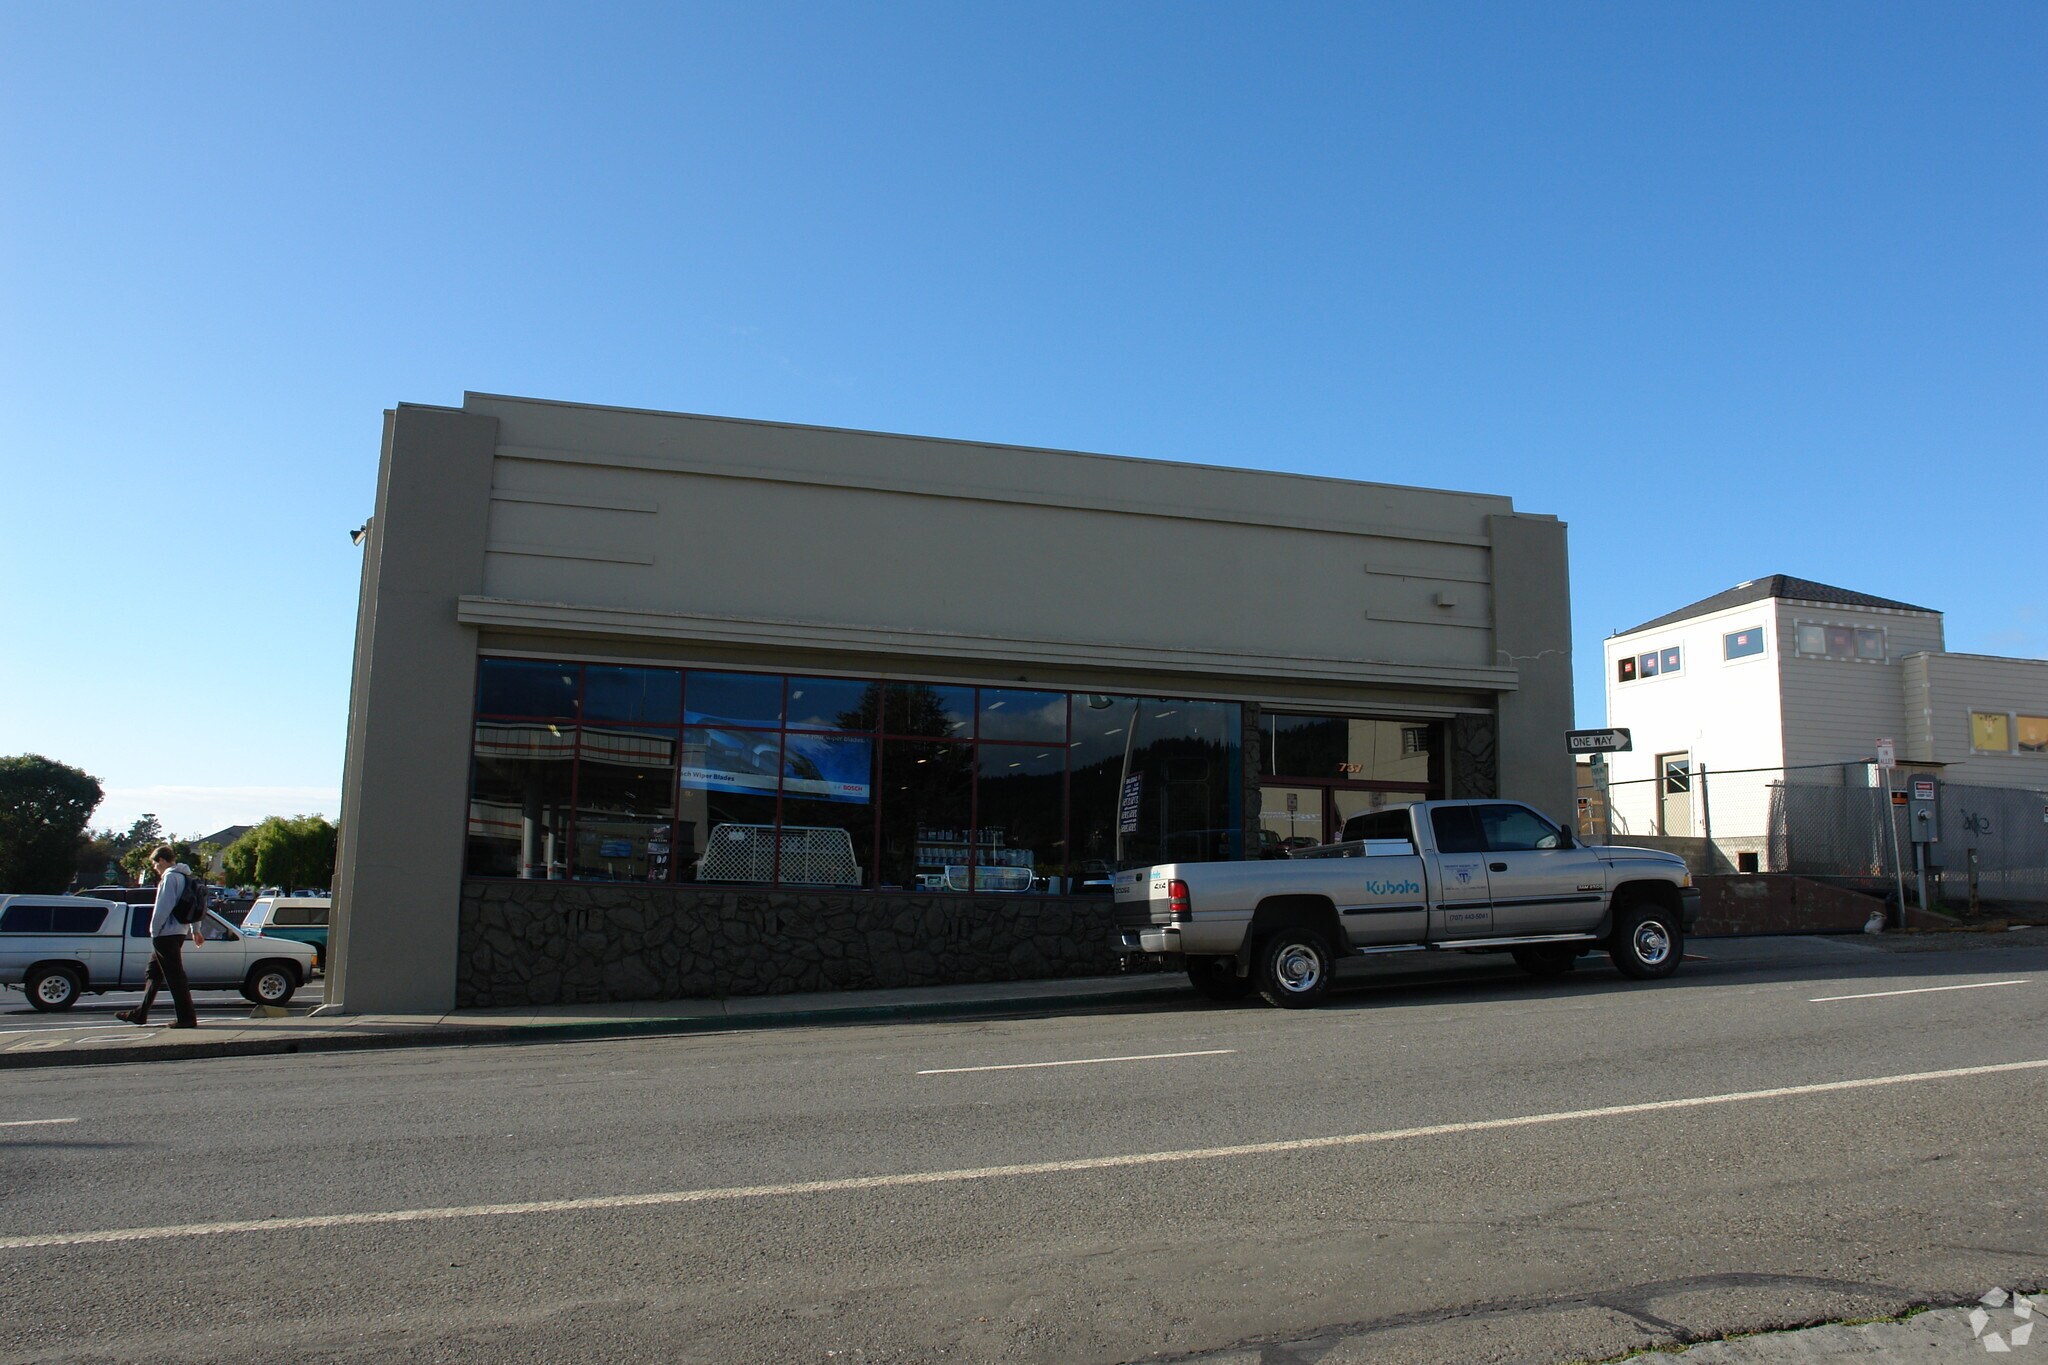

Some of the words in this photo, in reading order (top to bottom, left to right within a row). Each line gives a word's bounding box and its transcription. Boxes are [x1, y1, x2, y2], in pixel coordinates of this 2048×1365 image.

[1573, 738, 1591, 747] ONE
[1594, 736, 1613, 746] WAY
[1338, 762, 1364, 773] 737
[843, 784, 863, 792] BOSCH
[1366, 880, 1420, 895] Kubota
[1449, 914, 1464, 922] (707)
